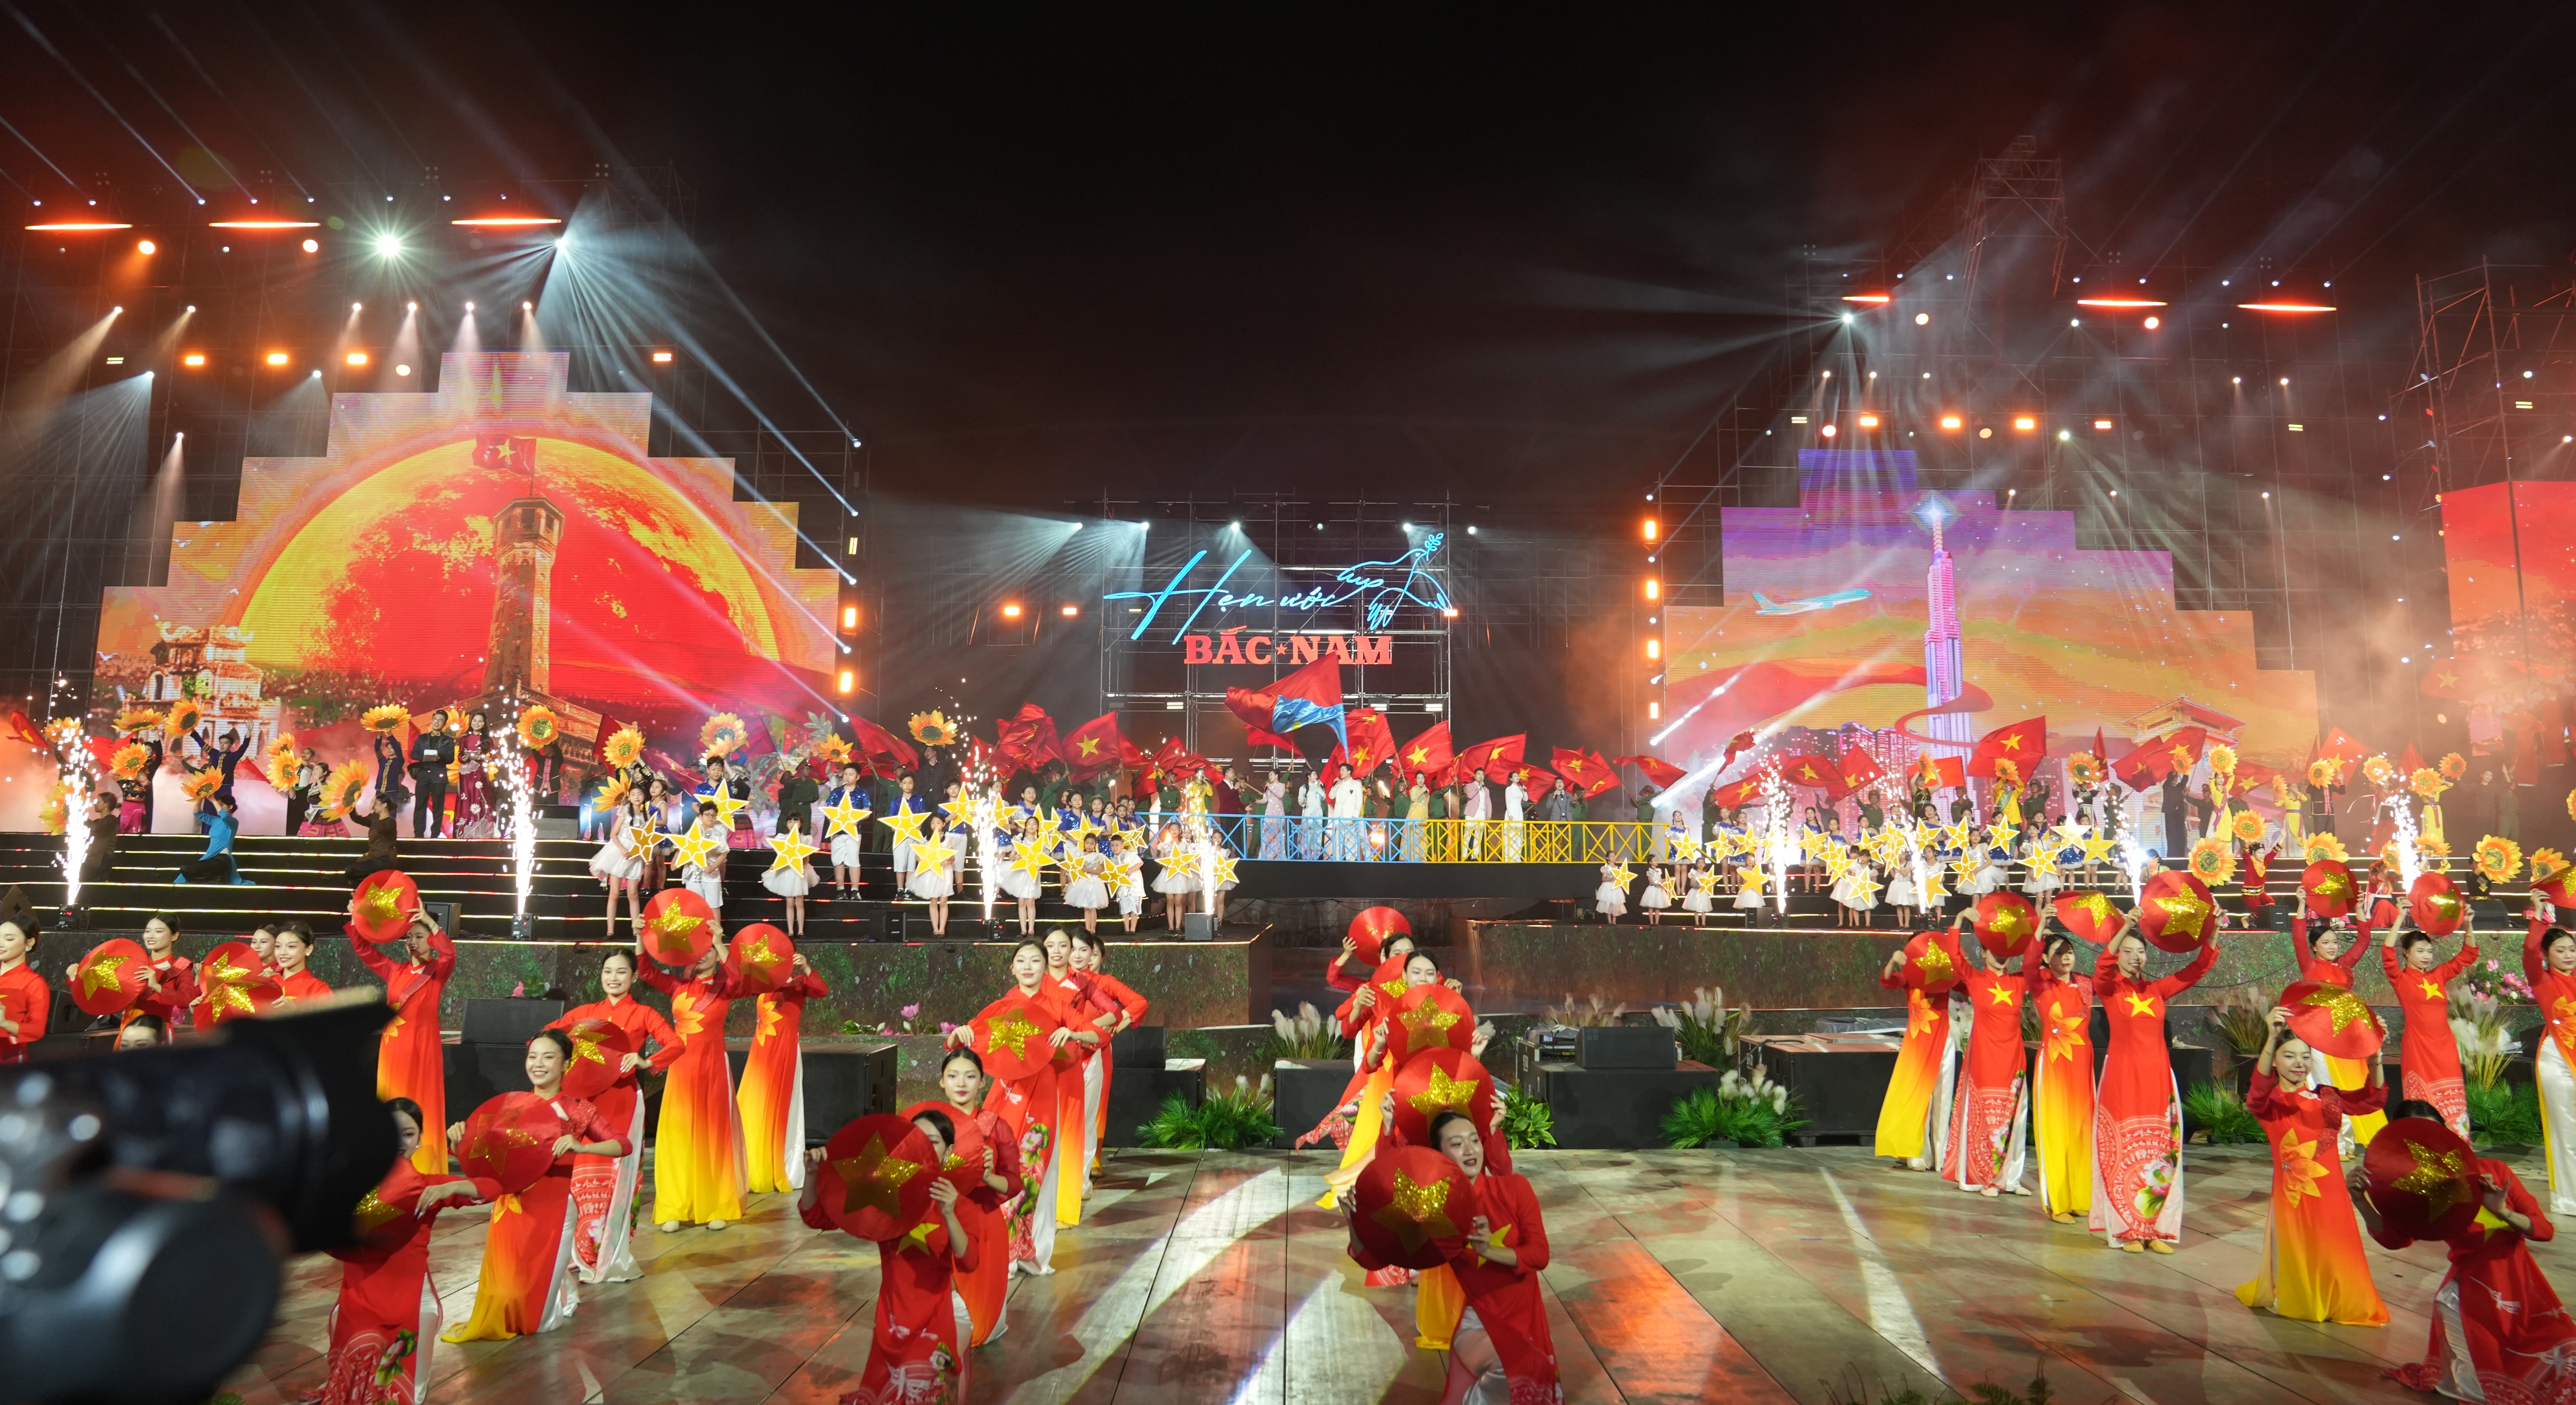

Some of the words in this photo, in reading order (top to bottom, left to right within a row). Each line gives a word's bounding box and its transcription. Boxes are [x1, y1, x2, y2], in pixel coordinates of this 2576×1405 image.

[1103, 549, 1275, 645] Hẹn
[1184, 625, 1272, 664] BẮC
[1290, 636, 1392, 665] NAM
